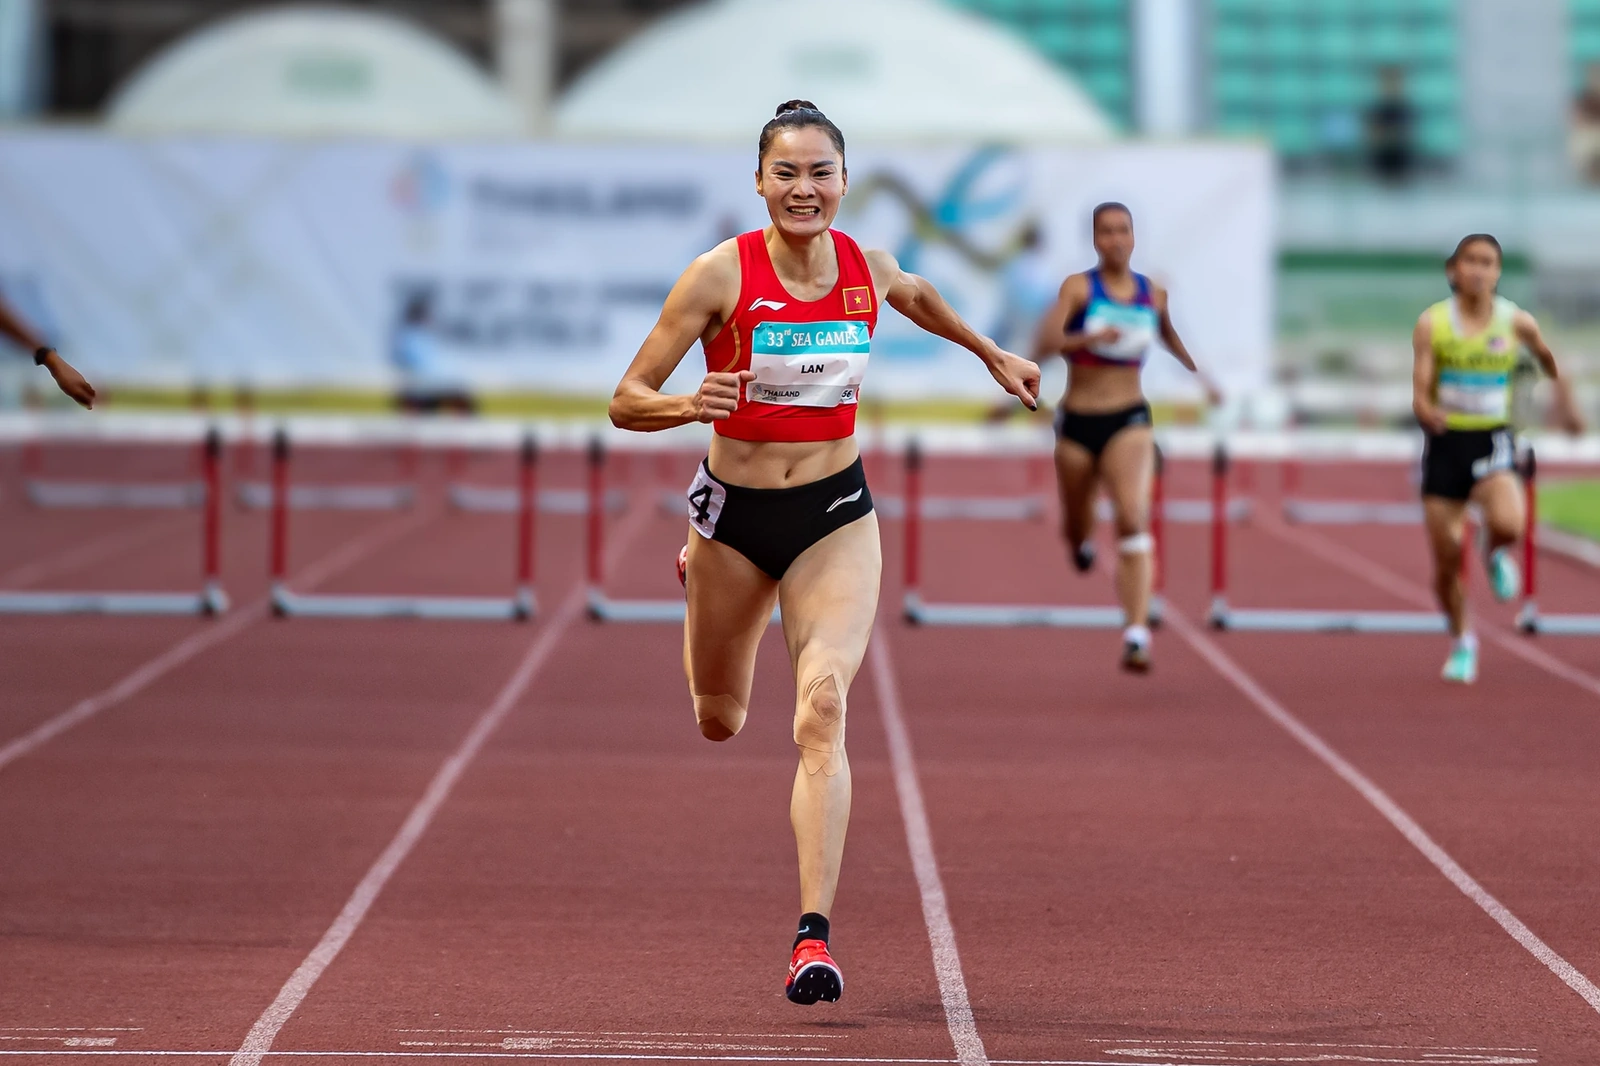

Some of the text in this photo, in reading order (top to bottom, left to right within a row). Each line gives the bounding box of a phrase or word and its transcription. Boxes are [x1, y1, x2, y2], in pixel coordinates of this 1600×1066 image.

[766, 329, 859, 347] 33rd SEA GAMES
[801, 364, 824, 374] LAN
[763, 389, 800, 398] THAILAND
[689, 484, 713, 525] 4
